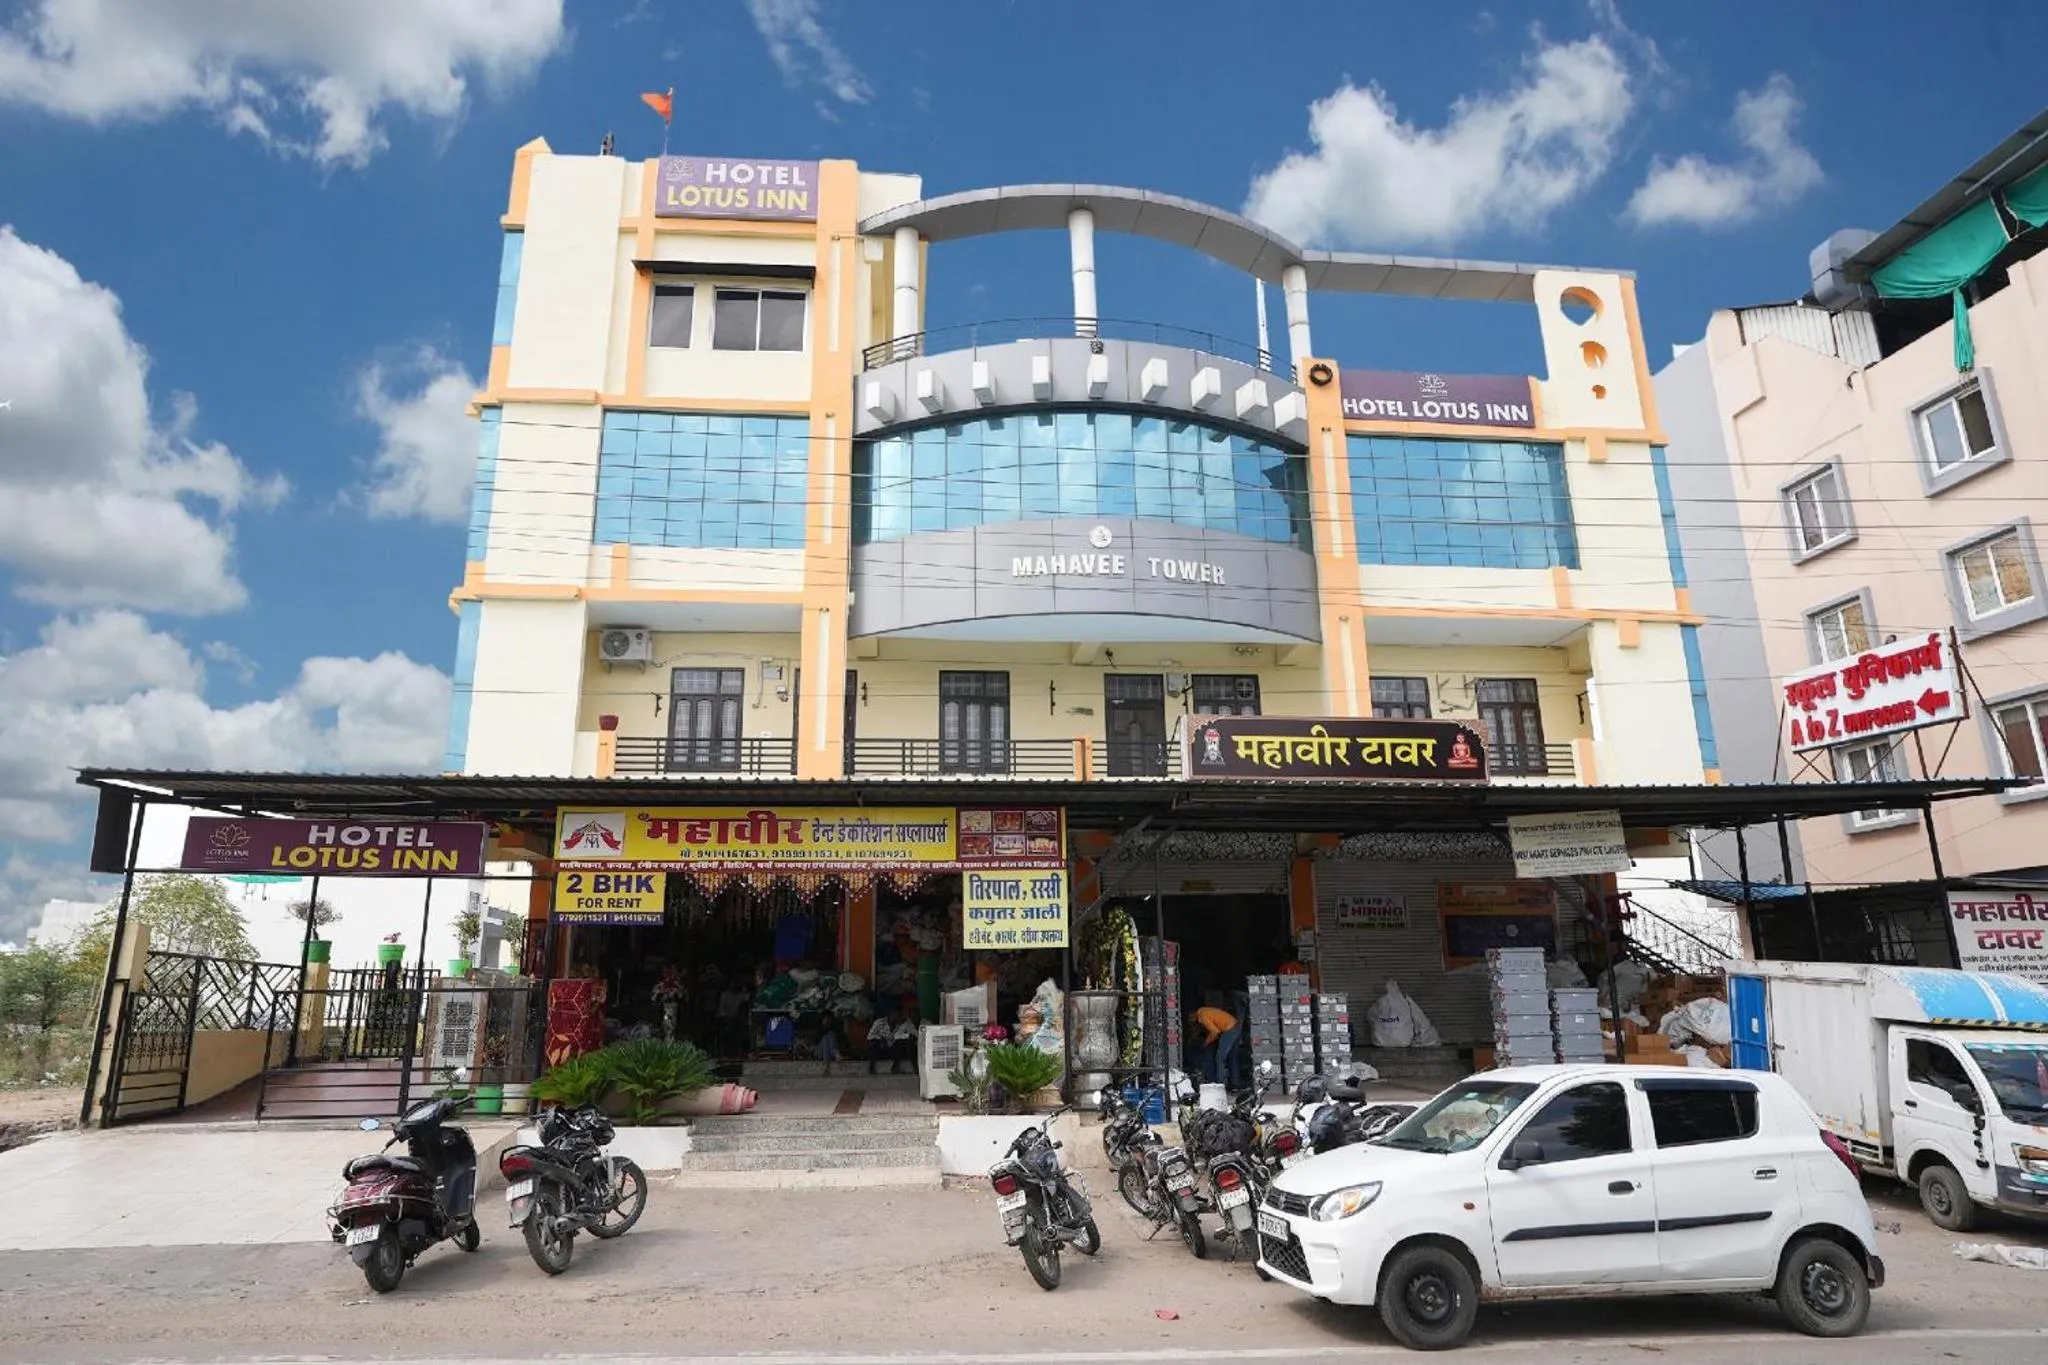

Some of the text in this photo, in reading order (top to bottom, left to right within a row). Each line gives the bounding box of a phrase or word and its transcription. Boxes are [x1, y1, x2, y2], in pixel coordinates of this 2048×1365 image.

[705, 163, 806, 186] HOTEL
[667, 185, 808, 211] LOTUS INN
[1343, 398, 1529, 421] HOTEL LOTUS INN
[1012, 554, 1226, 585] MAHAVEE TOWER
[1784, 671, 1837, 711] स्कूल
[1791, 700, 1916, 745] A to Z UNIFORMS
[1231, 725, 1437, 769] महावीर टावर
[308, 825, 434, 847] HOTEL
[646, 810, 808, 845] महावीर
[812, 818, 835, 843] टेन्ट
[838, 818, 894, 843] डेकोरेशन
[896, 818, 949, 843] सप्लायर्स
[271, 846, 458, 871] LOTUS INN
[566, 874, 656, 893] 2 BHK
[1030, 872, 1062, 899] रस्सी
[577, 897, 641, 908] FOR RENT
[1019, 903, 1062, 919] जाली
[1351, 906, 1403, 916] HIRING
[1951, 893, 2048, 922] महावीर
[1974, 929, 2045, 950] टावर
